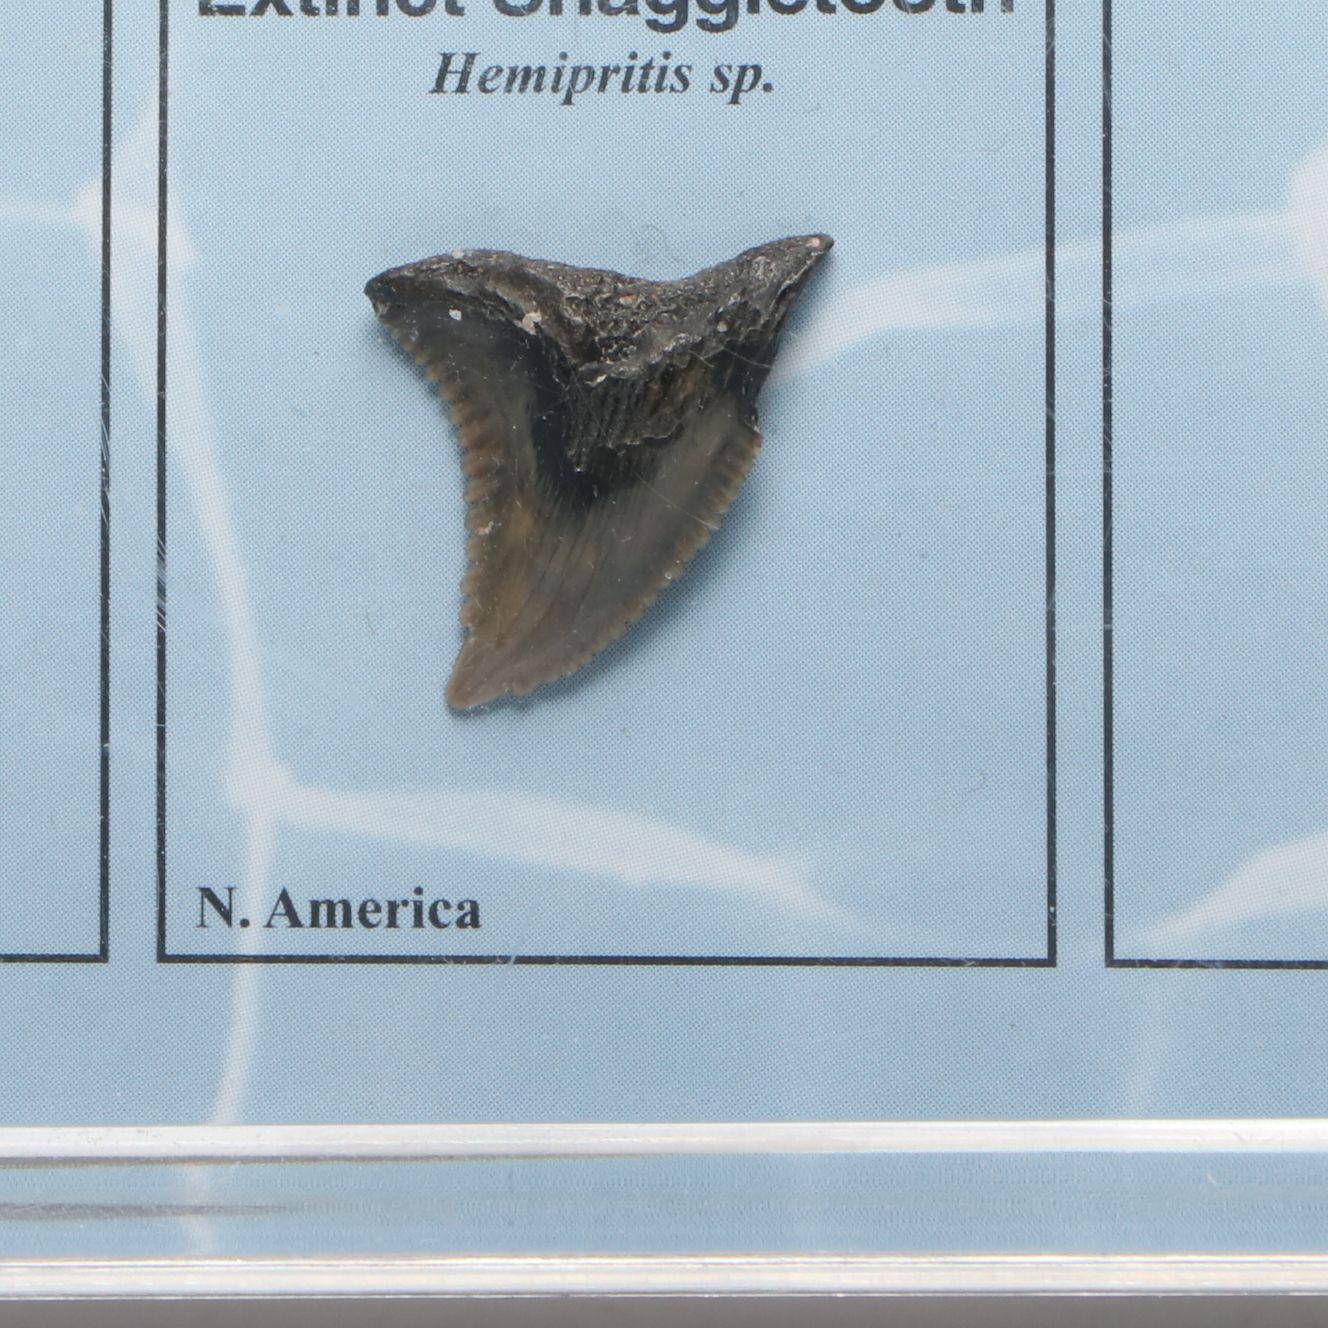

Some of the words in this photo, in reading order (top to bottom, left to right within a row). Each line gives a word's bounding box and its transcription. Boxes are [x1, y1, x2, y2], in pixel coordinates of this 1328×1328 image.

[427, 51, 692, 106] Hemipritis
[709, 63, 774, 105] sp.
[196, 885, 252, 930] N.
[262, 885, 483, 930] America
